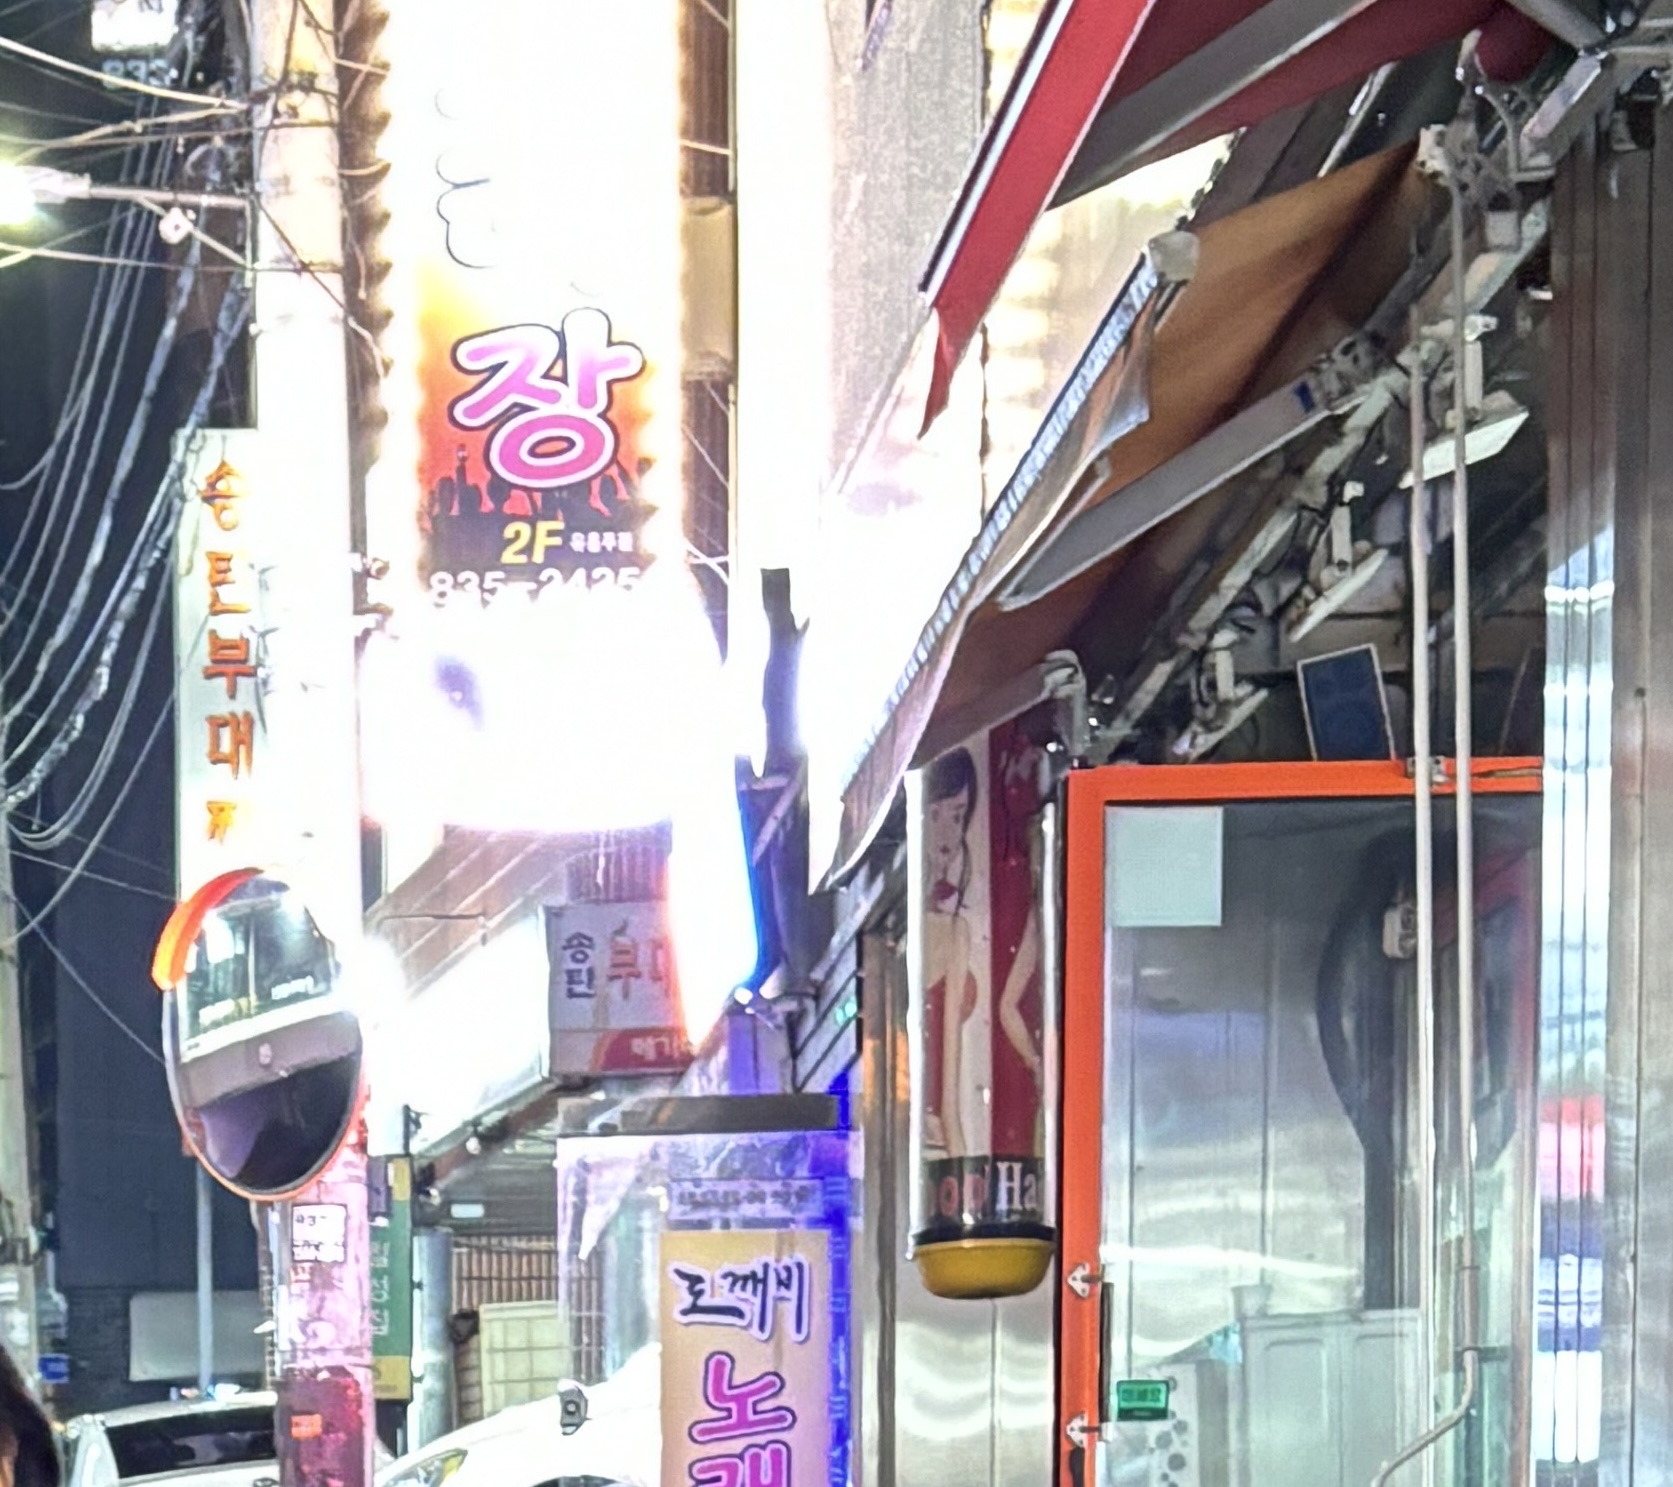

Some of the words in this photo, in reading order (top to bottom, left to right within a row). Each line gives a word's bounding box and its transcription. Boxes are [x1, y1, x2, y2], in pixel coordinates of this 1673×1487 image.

[500, 520, 565, 565] 2F
[561, 931, 596, 1000] 송탄
[671, 1257, 808, 1340] 도깨비
